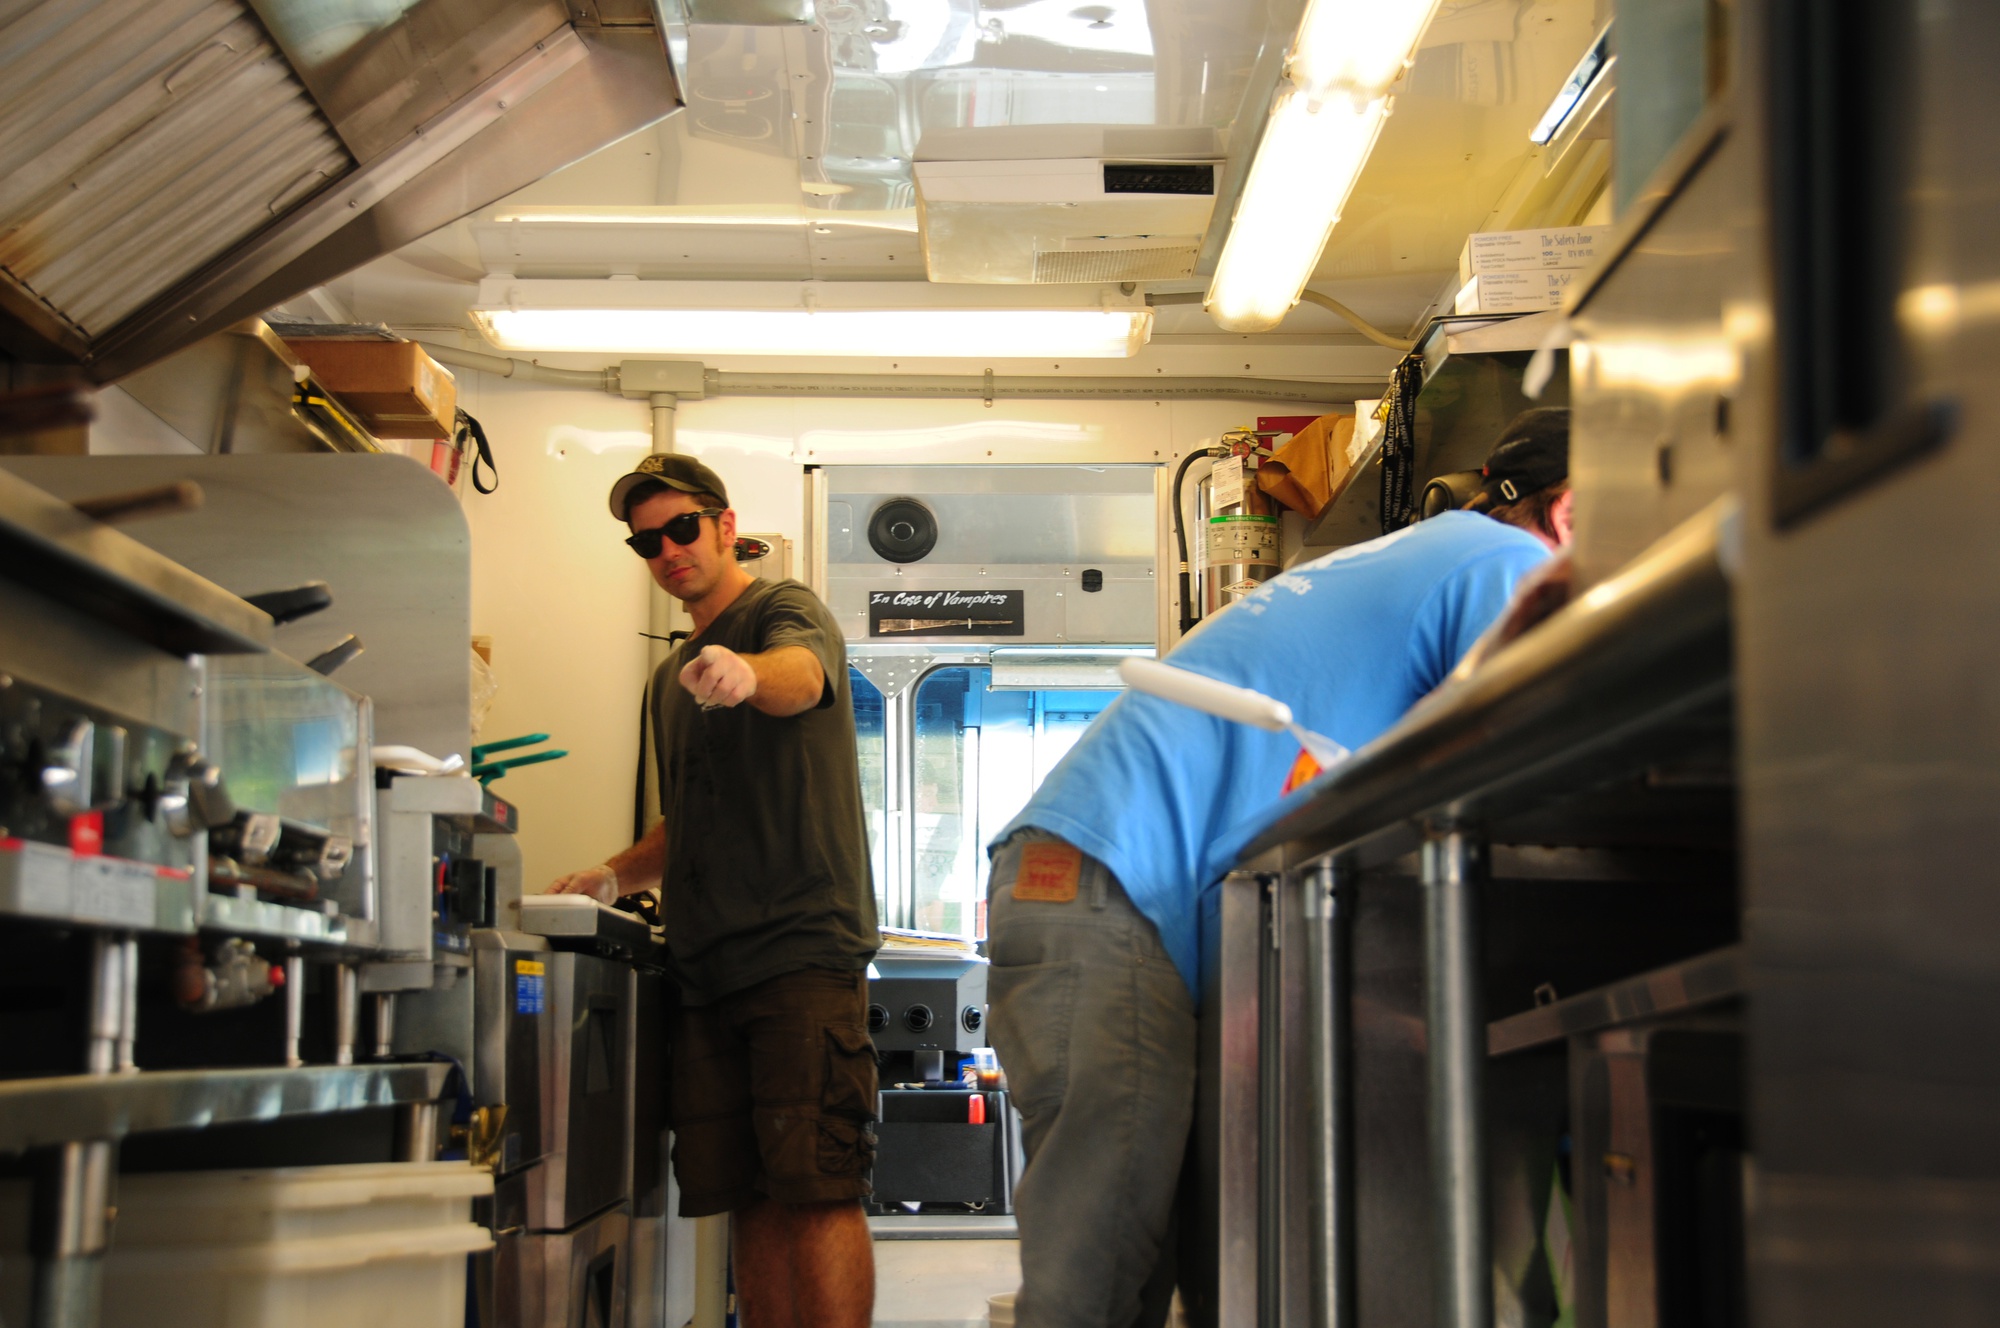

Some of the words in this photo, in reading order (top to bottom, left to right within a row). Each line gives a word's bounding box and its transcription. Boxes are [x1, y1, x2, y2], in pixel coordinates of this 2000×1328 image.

[1540, 235, 1553, 247] The
[1554, 234, 1575, 247] Safety
[1576, 232, 1592, 245] Zone
[1547, 274, 1559, 287] The
[870, 593, 890, 605] In
[893, 592, 922, 607] Case
[923, 592, 943, 608] of
[943, 591, 1008, 608] Vampires
